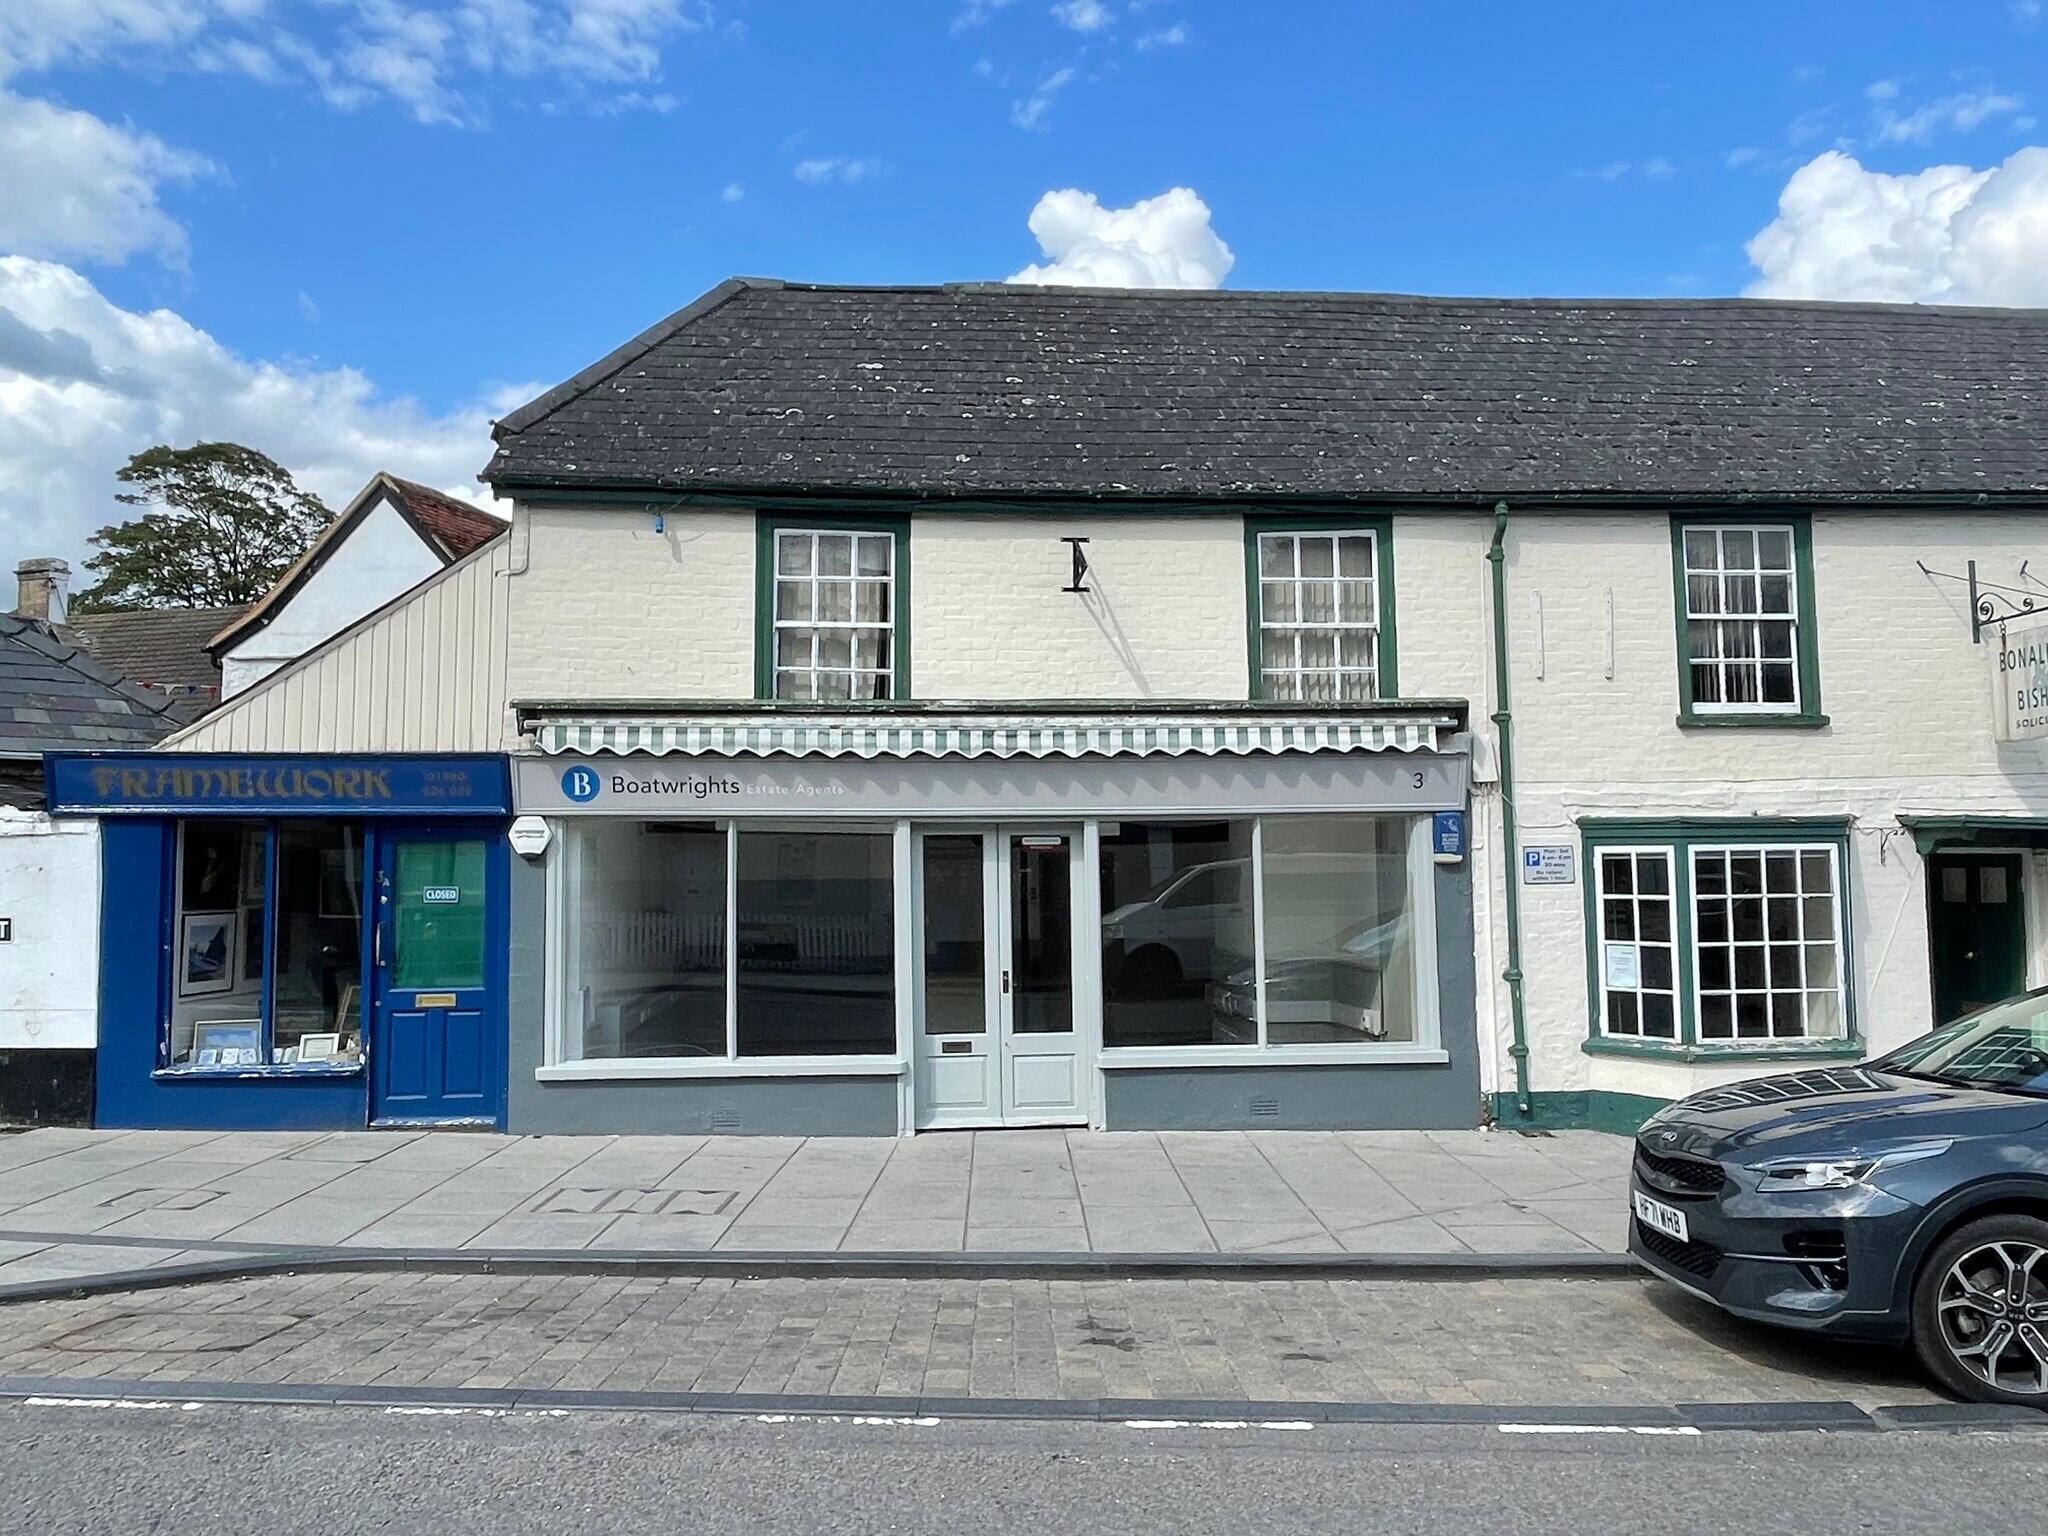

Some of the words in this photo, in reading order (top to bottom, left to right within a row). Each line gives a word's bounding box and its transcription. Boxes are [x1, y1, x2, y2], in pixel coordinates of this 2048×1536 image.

[2017, 686, 2048, 710] BISH
[92, 766, 392, 799] FRAMEWORK
[572, 772, 591, 796] B
[612, 776, 740, 798] Boatwrights
[746, 783, 789, 794] Estate
[796, 783, 844, 797] Agents
[1413, 772, 1424, 789] 3
[1528, 853, 1539, 866] P
[426, 889, 456, 900] CLOSED
